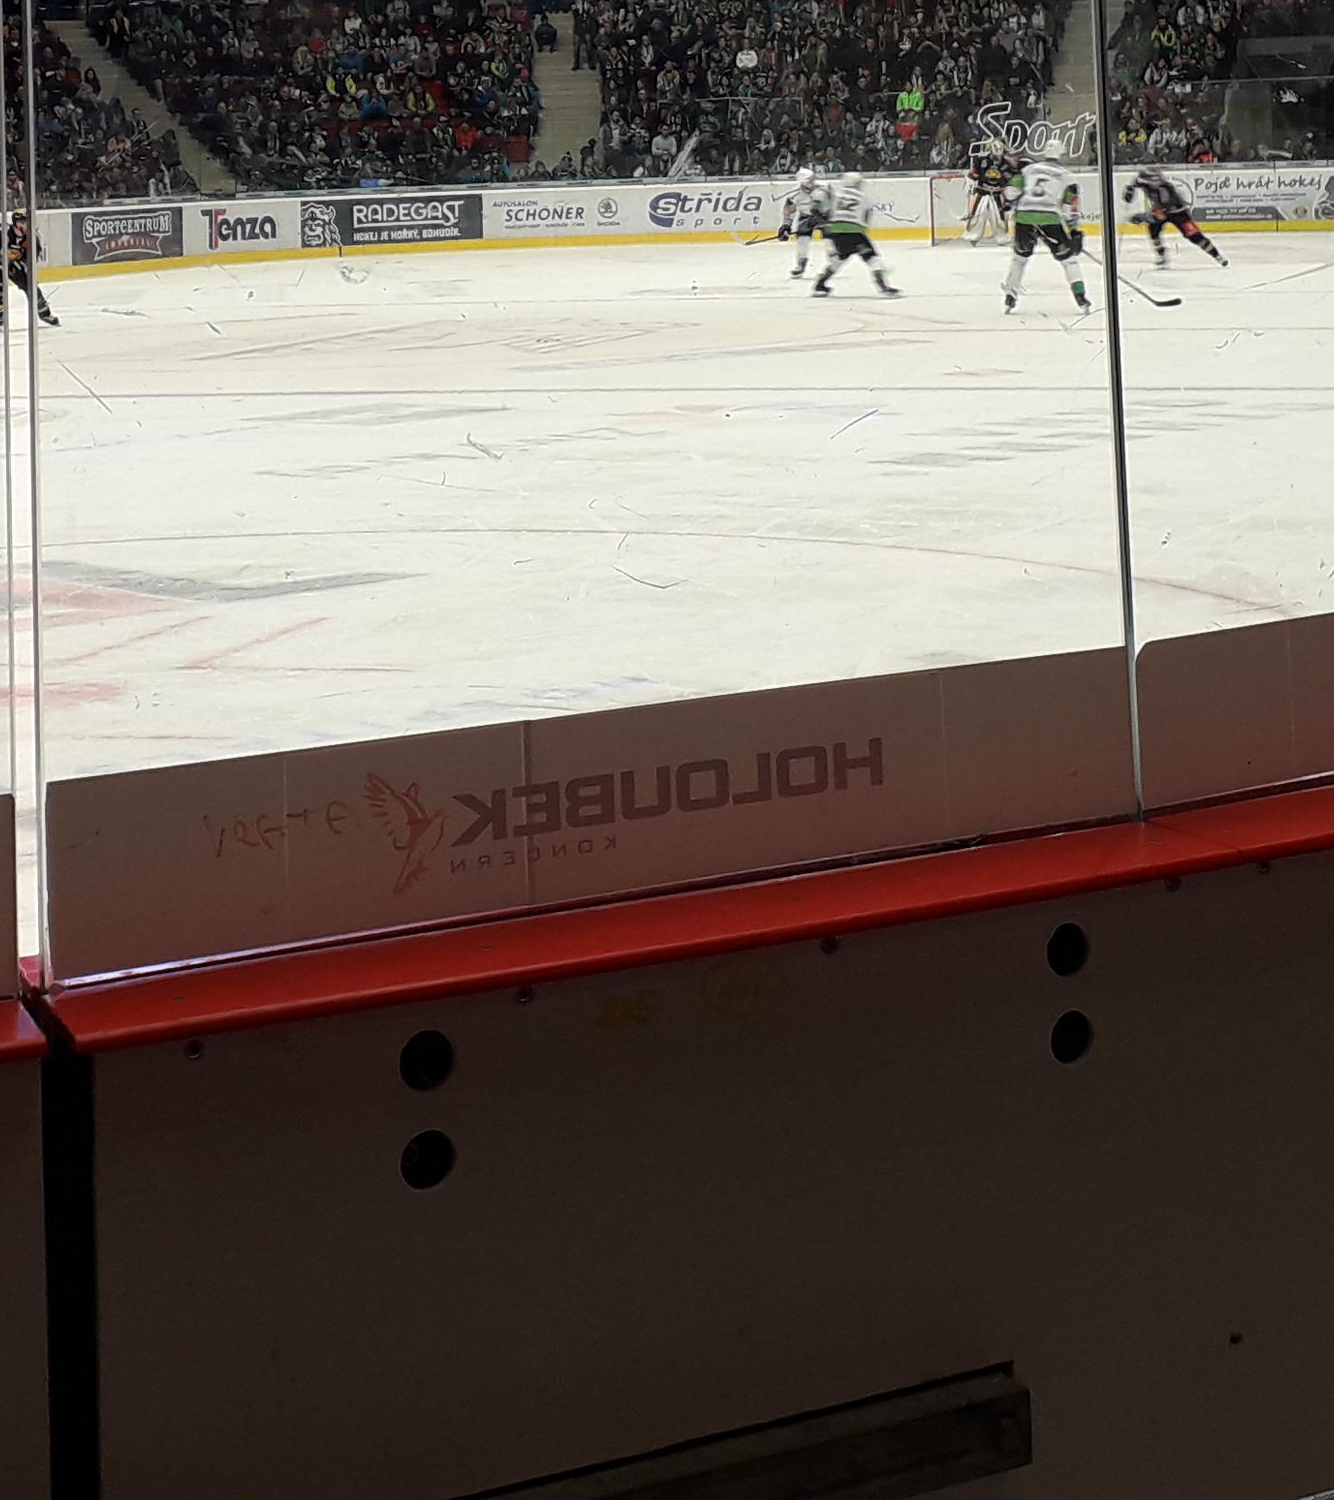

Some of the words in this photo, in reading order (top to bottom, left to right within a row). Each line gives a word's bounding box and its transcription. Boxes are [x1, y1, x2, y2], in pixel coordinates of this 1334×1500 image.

[1277, 173, 1323, 190] hokej
[85, 214, 170, 238] SPORTCENTRUM
[352, 200, 465, 229] RADEGAST
